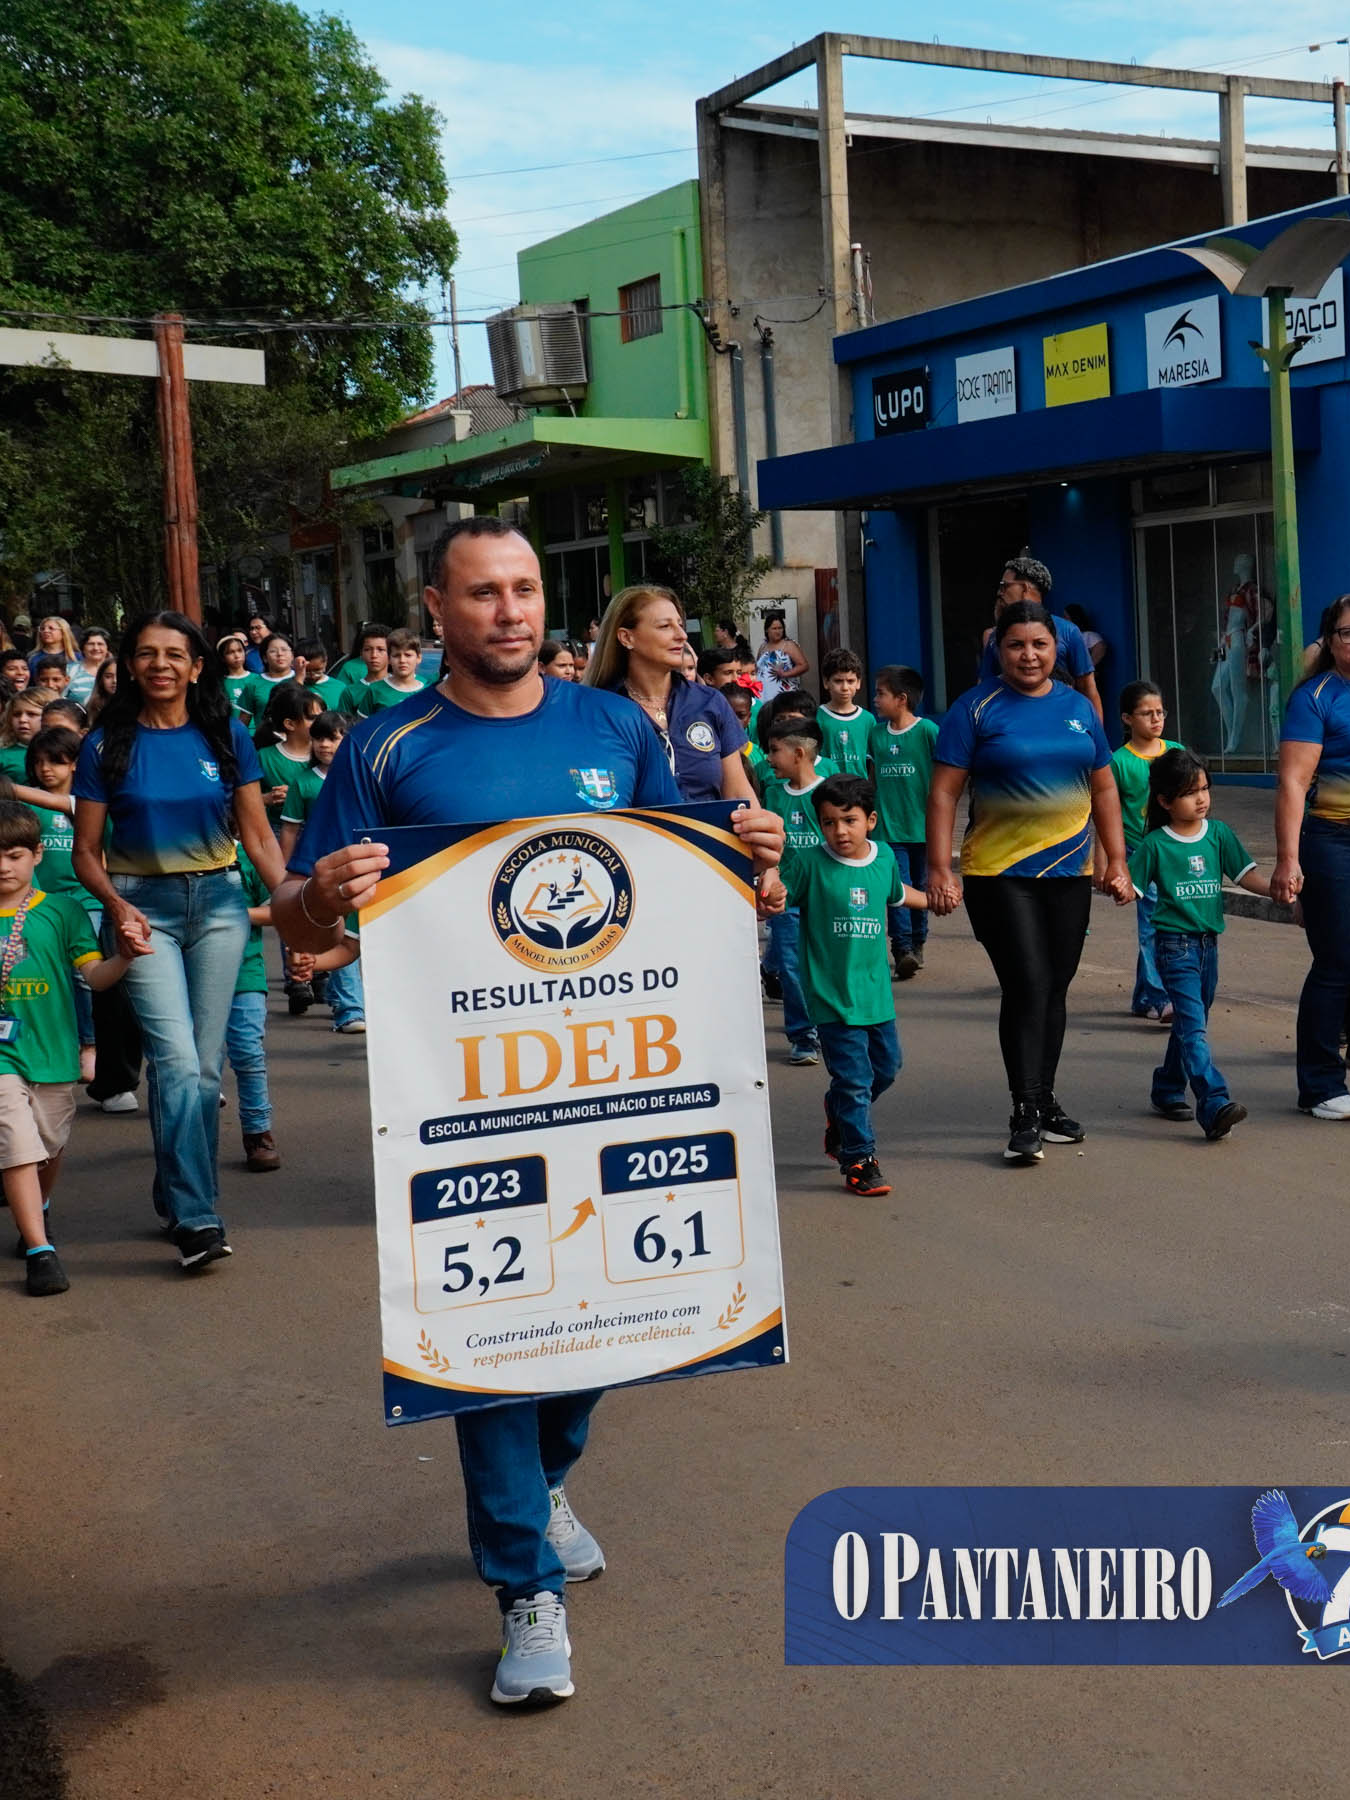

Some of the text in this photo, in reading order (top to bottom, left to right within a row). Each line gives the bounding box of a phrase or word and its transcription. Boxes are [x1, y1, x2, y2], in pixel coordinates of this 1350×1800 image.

[1285, 300, 1337, 335] PACO
[957, 369, 1013, 402] DOCE TRAMA
[1046, 354, 1107, 379] MAX DENIM
[1158, 358, 1210, 385] MARESIA
[875, 386, 925, 427] LUPO
[41, 838, 74, 849] ONIT
[500, 835, 621, 884] ESCOLA MUNICIPAL
[1176, 883, 1221, 897] BONITO
[512, 939, 546, 963] MANOEL
[548, 955, 580, 966] INÁCIO
[590, 929, 617, 955] FARIAS
[832, 921, 882, 935] BONITO
[5, 982, 49, 996] NITO
[451, 967, 679, 1013] RESULTADOS DO
[455, 1014, 682, 1102] IDEB
[428, 1090, 711, 1138] ESCOLA MUNICIPAL MANOEL INÁCIO DE FARIAS
[627, 1144, 709, 1182] 2025
[436, 1169, 521, 1209] 2023
[633, 1210, 712, 1269] 6,1
[442, 1236, 525, 1296] 5,2
[466, 1304, 701, 1349] Construindo conhecimento com
[473, 1323, 696, 1369] responsabilidade e excelência.
